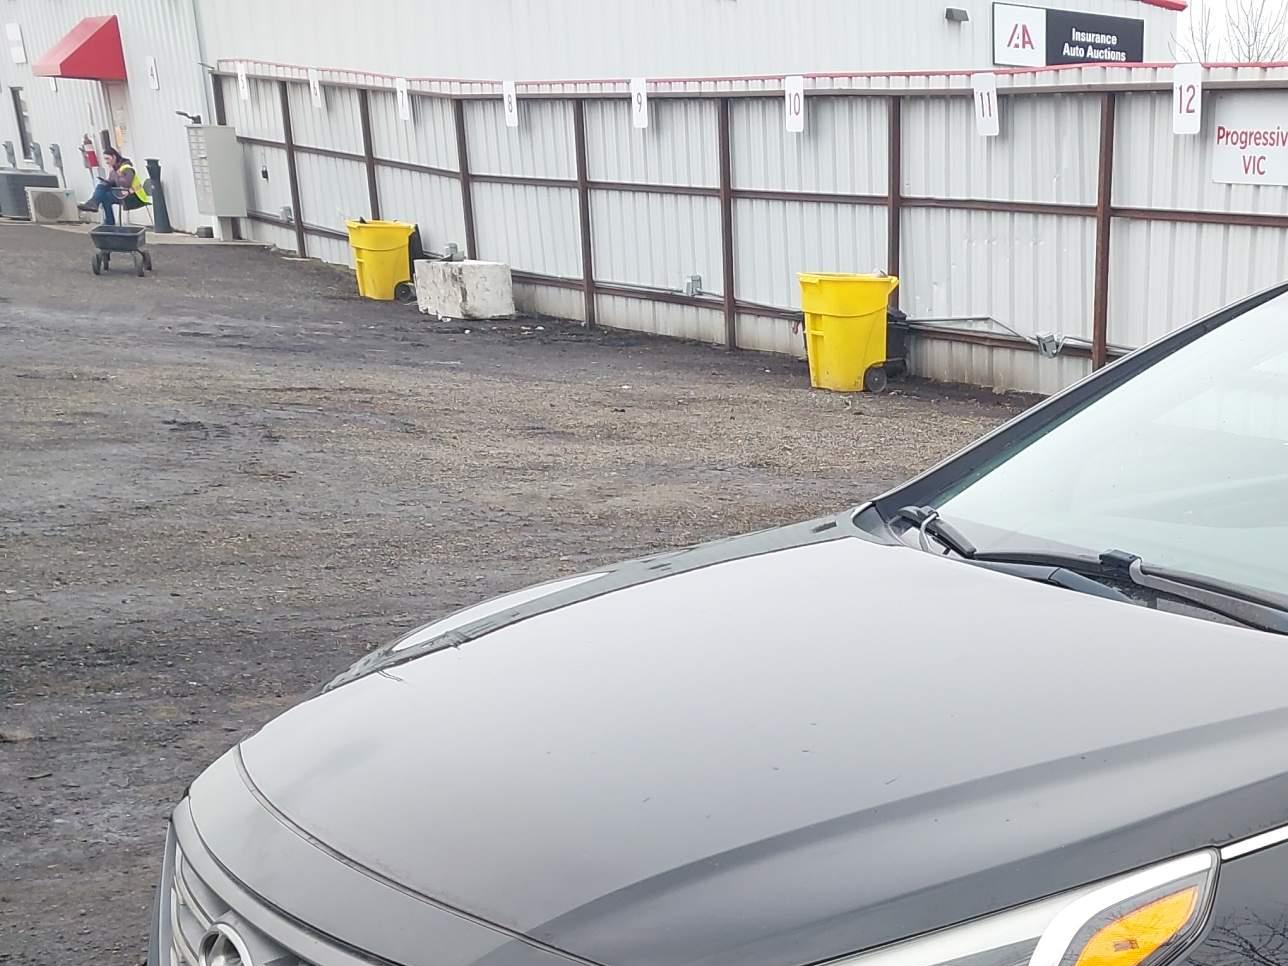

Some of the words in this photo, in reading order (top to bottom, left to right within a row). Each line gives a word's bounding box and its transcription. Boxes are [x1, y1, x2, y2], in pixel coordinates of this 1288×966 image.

[1072, 28, 1118, 46] Insurance
[1063, 42, 1085, 58] Auto
[1086, 45, 1127, 62] Auctions
[507, 93, 513, 113] 8
[636, 92, 643, 113] 9
[788, 92, 801, 116] 10
[978, 91, 992, 118] 11
[1178, 84, 1196, 114] 12
[1242, 155, 1266, 175] VIC
